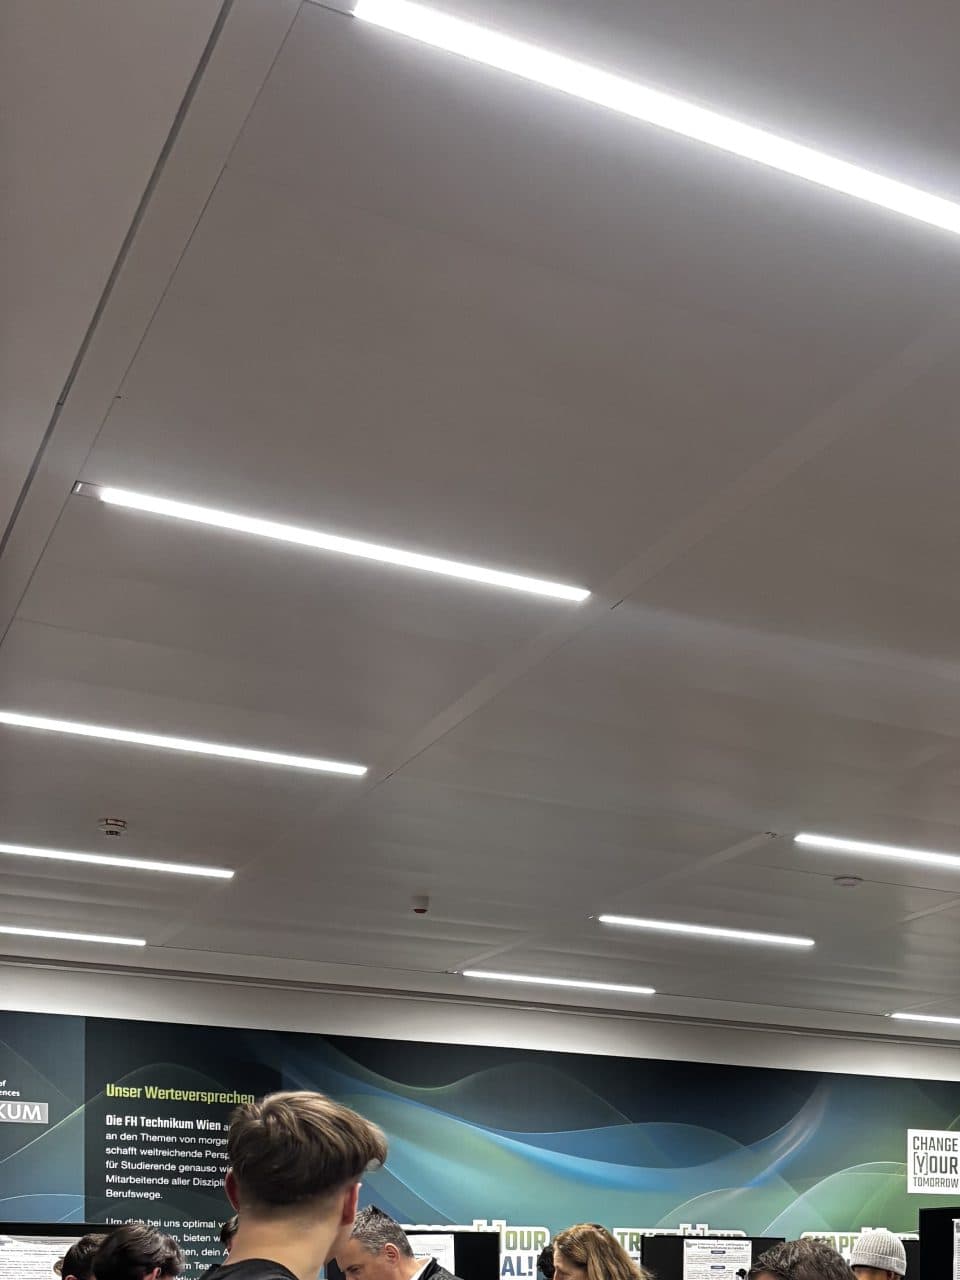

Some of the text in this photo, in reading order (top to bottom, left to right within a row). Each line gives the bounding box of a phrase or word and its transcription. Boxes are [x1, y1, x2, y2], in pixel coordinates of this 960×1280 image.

[106, 1083, 255, 1105] Unser Werteversprechen
[105, 1114, 123, 1126] Die
[124, 1116, 138, 1128] FH
[140, 1116, 194, 1130] Technikum
[196, 1119, 221, 1131] Wien
[105, 1133, 117, 1141] an
[120, 1132, 137, 1141] den
[139, 1133, 176, 1143] Themen
[179, 1136, 196, 1144] von
[913, 1136, 959, 1152] CHANGE
[105, 1146, 137, 1155] schafft
[139, 1148, 203, 1158] weitreichende
[105, 1160, 118, 1169] für
[120, 1161, 176, 1171] Studierende
[178, 1164, 217, 1174] genauso
[105, 1175, 169, 1185] Mitarbeitende
[171, 1177, 190, 1186] aller
[913, 1176, 959, 1188] TOMORROW
[105, 1188, 163, 1200] Berufswege.
[147, 1218, 161, 1228] bei
[164, 1220, 180, 1228] uns
[183, 1219, 215, 1230] optimal
[183, 1234, 211, 1242] bieten
[201, 1248, 220, 1256] dein
[194, 1261, 212, 1270] Tea
